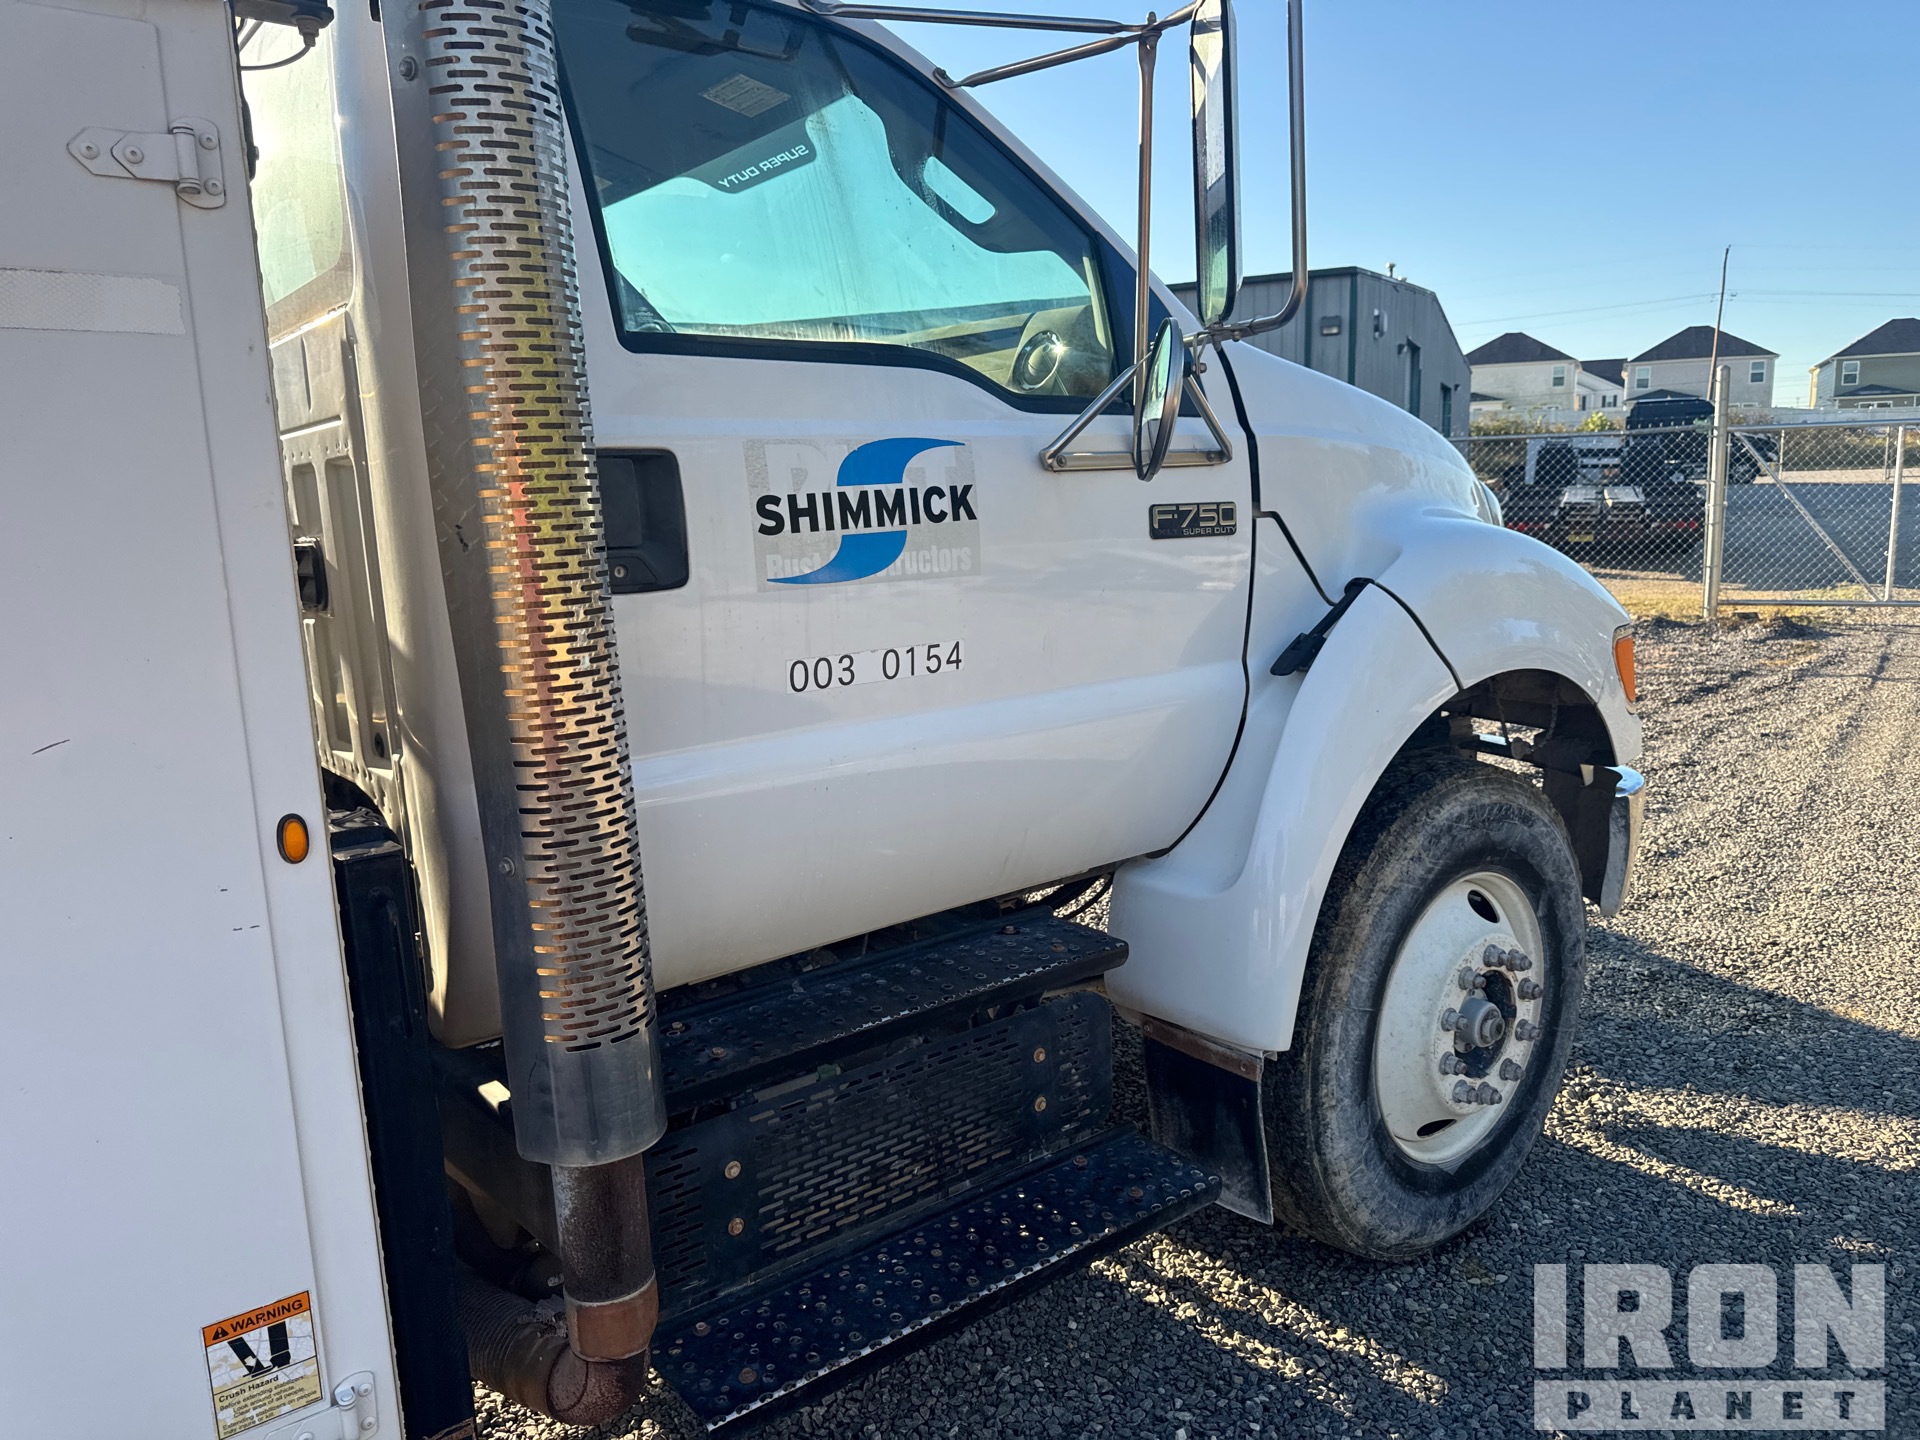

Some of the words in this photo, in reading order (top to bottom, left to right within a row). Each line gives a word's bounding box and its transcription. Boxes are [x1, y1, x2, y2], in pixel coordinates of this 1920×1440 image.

[756, 484, 977, 536] SHIMMICK
[1183, 526, 1212, 535] SUPER
[789, 654, 856, 693] 003
[882, 640, 962, 680] 0154
[230, 1299, 303, 1333] WARNING
[218, 1388, 246, 1403] Crush
[248, 1375, 279, 1391] Hazard
[219, 1400, 241, 1412] Before
[242, 1387, 273, 1402] extending
[222, 1415, 255, 1431] Extending
[255, 1402, 287, 1417] stabilizers
[296, 1390, 318, 1402] people
[233, 1403, 249, 1413] Look
[250, 1393, 272, 1406] around
[233, 1408, 251, 1418] Clear
[252, 1402, 267, 1411] area
[275, 1394, 284, 1402] all
[223, 1428, 238, 1436] may
[239, 1420, 256, 1430] injure
